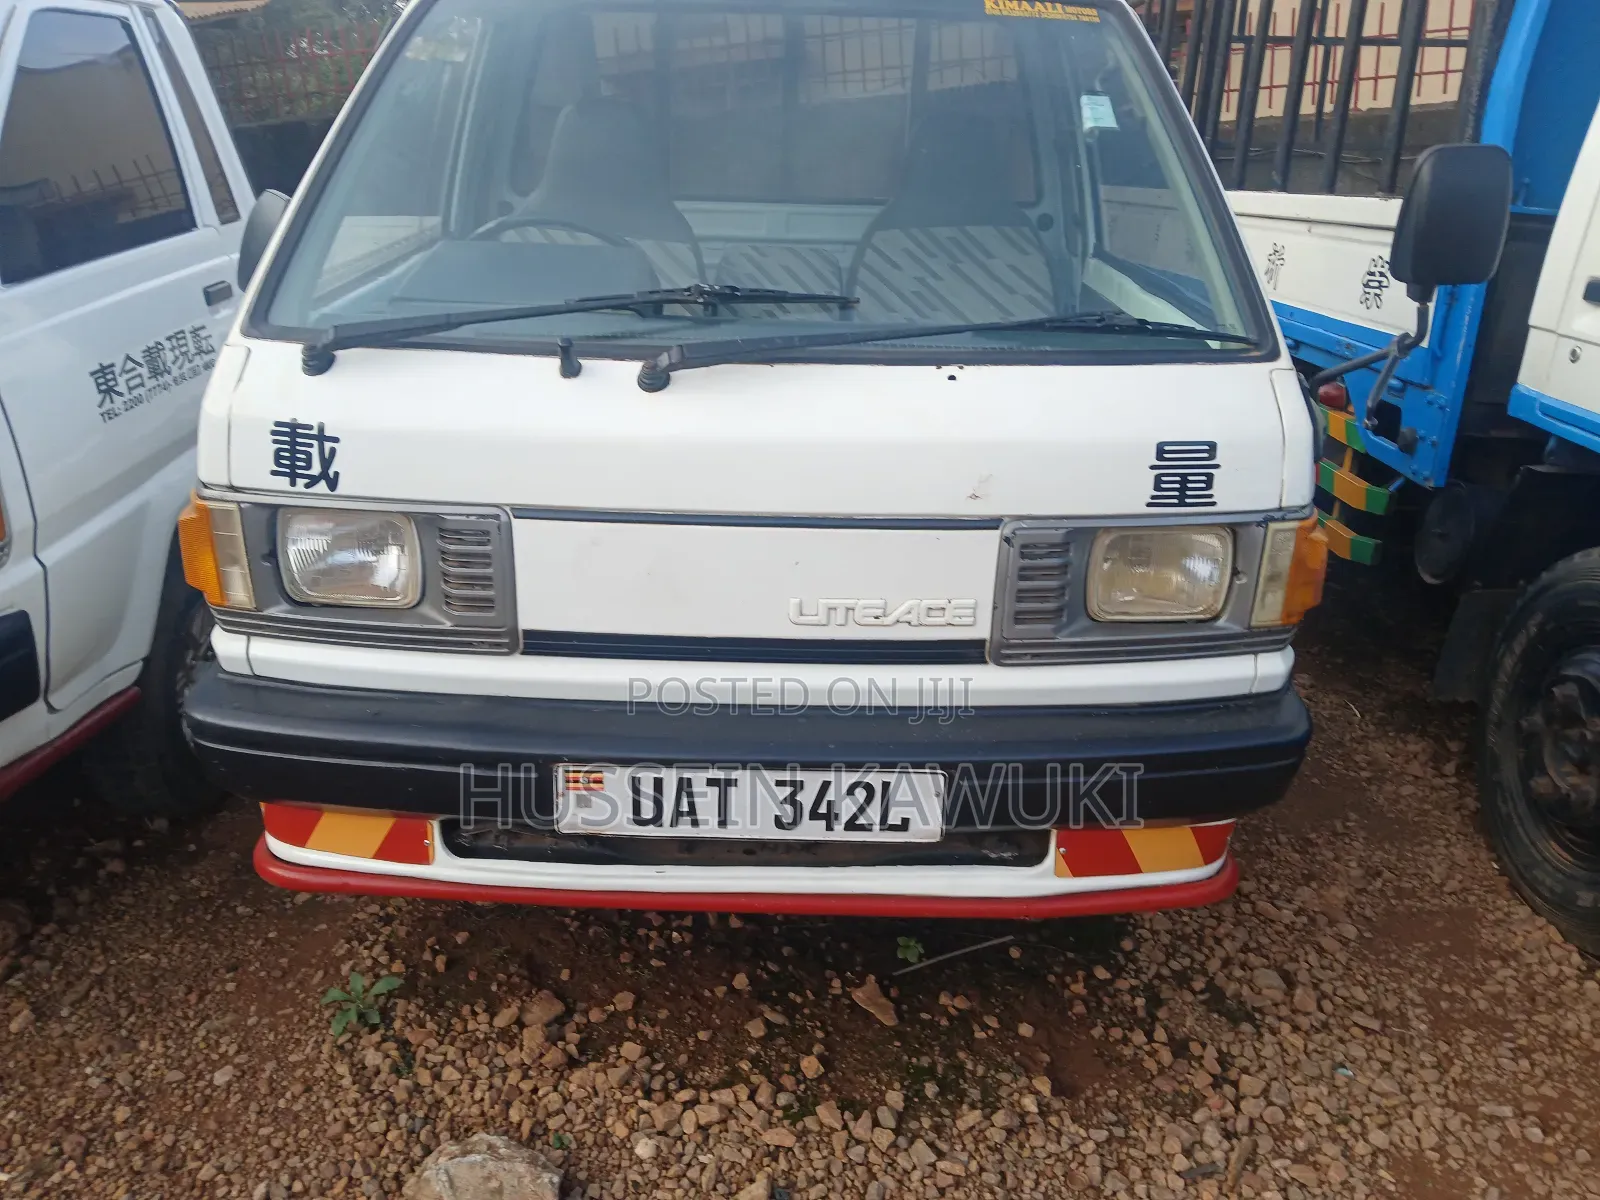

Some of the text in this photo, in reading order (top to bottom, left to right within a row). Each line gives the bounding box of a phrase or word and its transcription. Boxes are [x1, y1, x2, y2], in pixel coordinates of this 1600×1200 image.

[270, 418, 340, 492] 載
[1145, 441, 1221, 507] 量
[630, 773, 910, 833] UAT 342L
